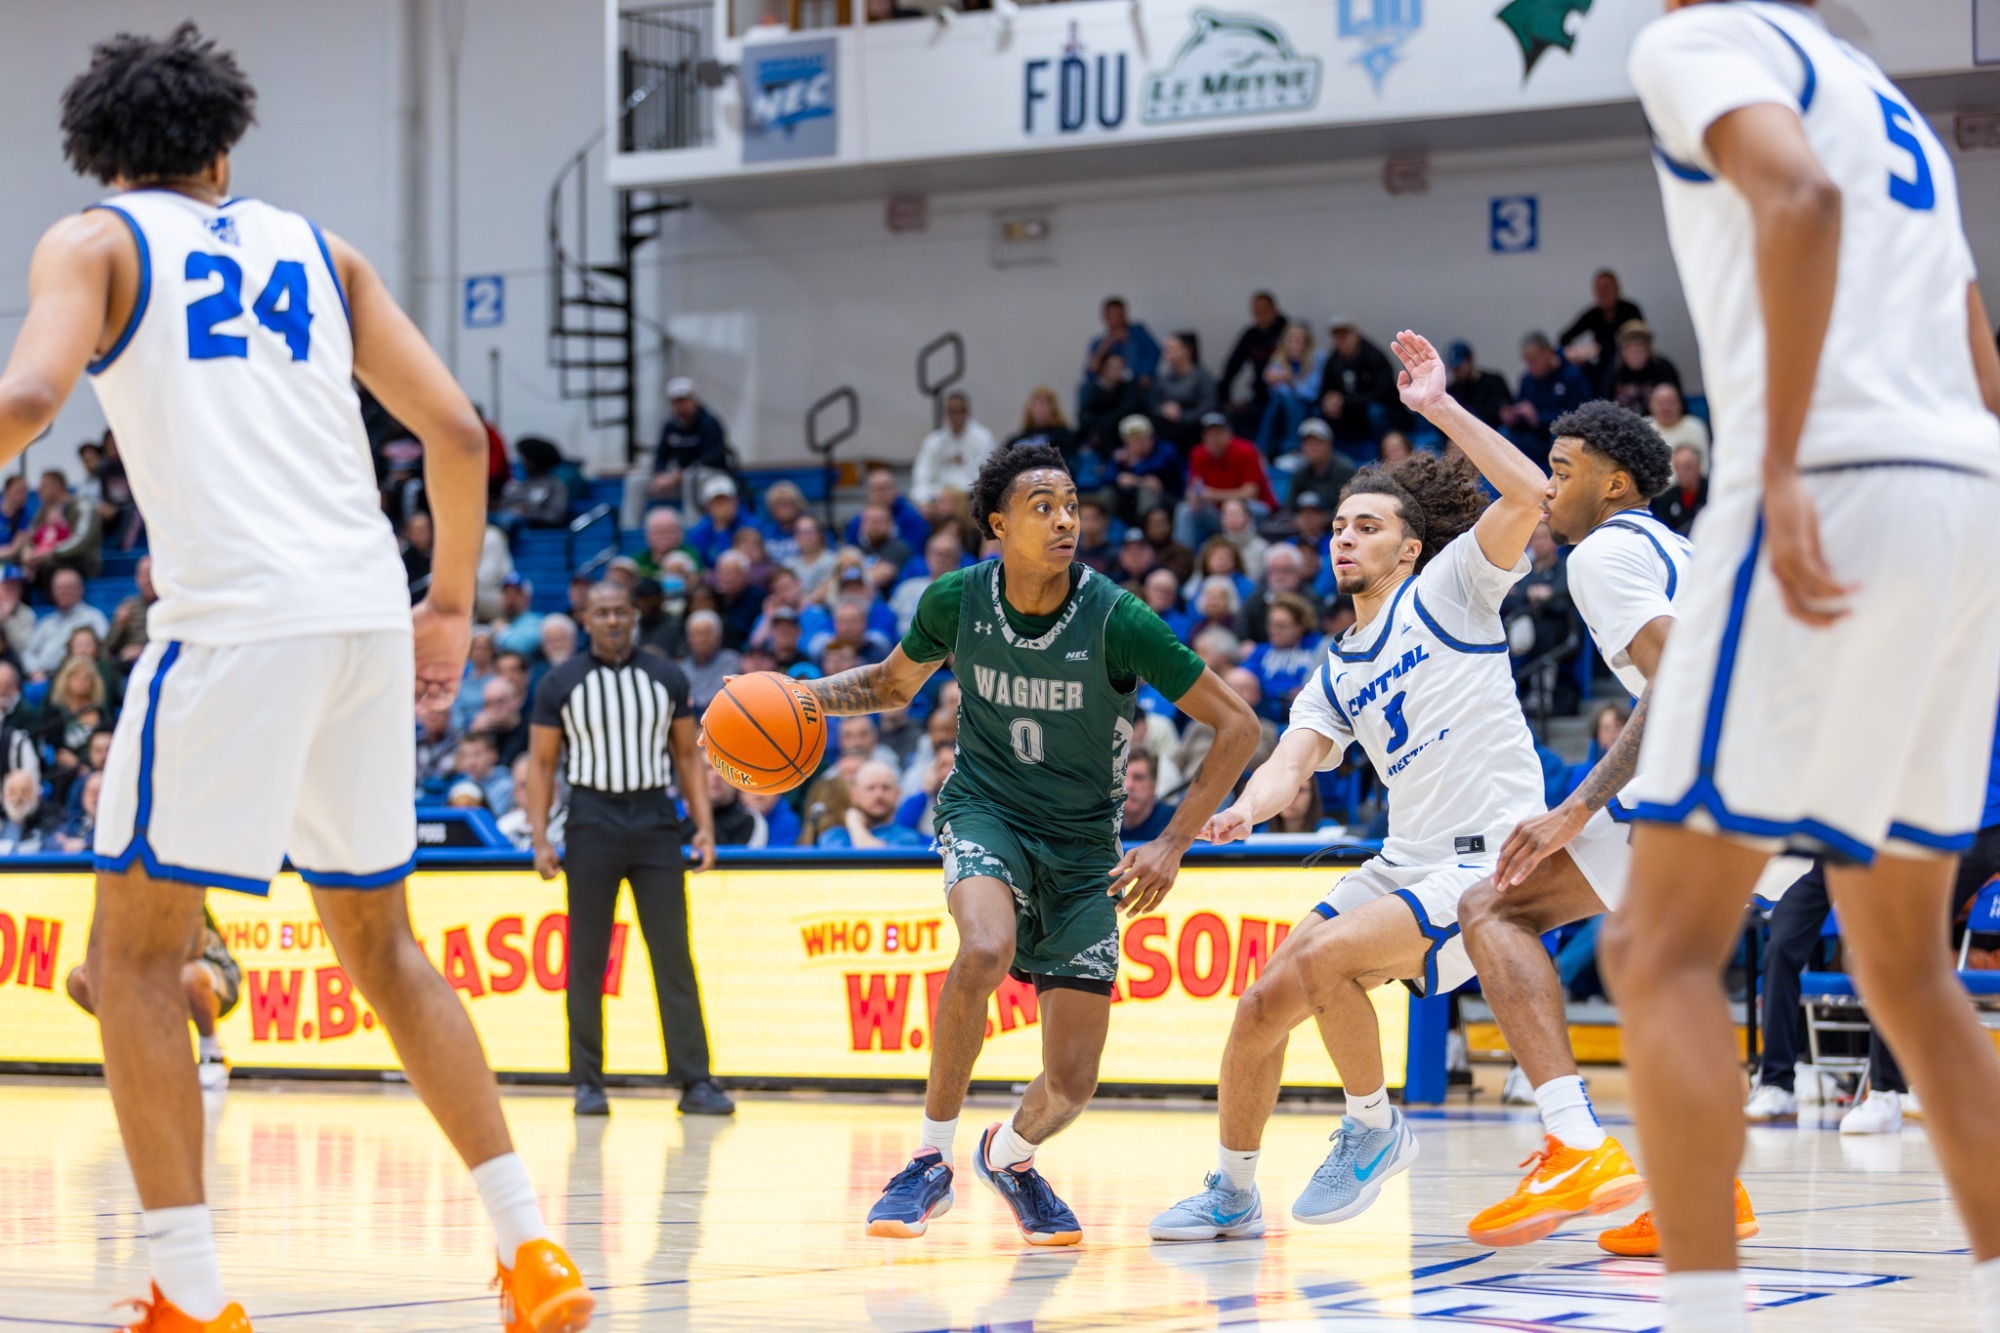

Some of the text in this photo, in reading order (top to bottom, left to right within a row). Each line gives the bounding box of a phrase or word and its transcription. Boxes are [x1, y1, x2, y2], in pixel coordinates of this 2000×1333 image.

[1024, 54, 1128, 132] FDU
[1872, 88, 1935, 210] 5
[1496, 201, 1532, 247] 3
[185, 251, 314, 362] 24
[471, 284, 497, 320] 2
[1065, 650, 1089, 661] NEC
[973, 664, 1084, 712] WAGNER
[1009, 717, 1045, 765] 0
[1474, 840, 1480, 848] L
[801, 920, 941, 957] WHO BUT
